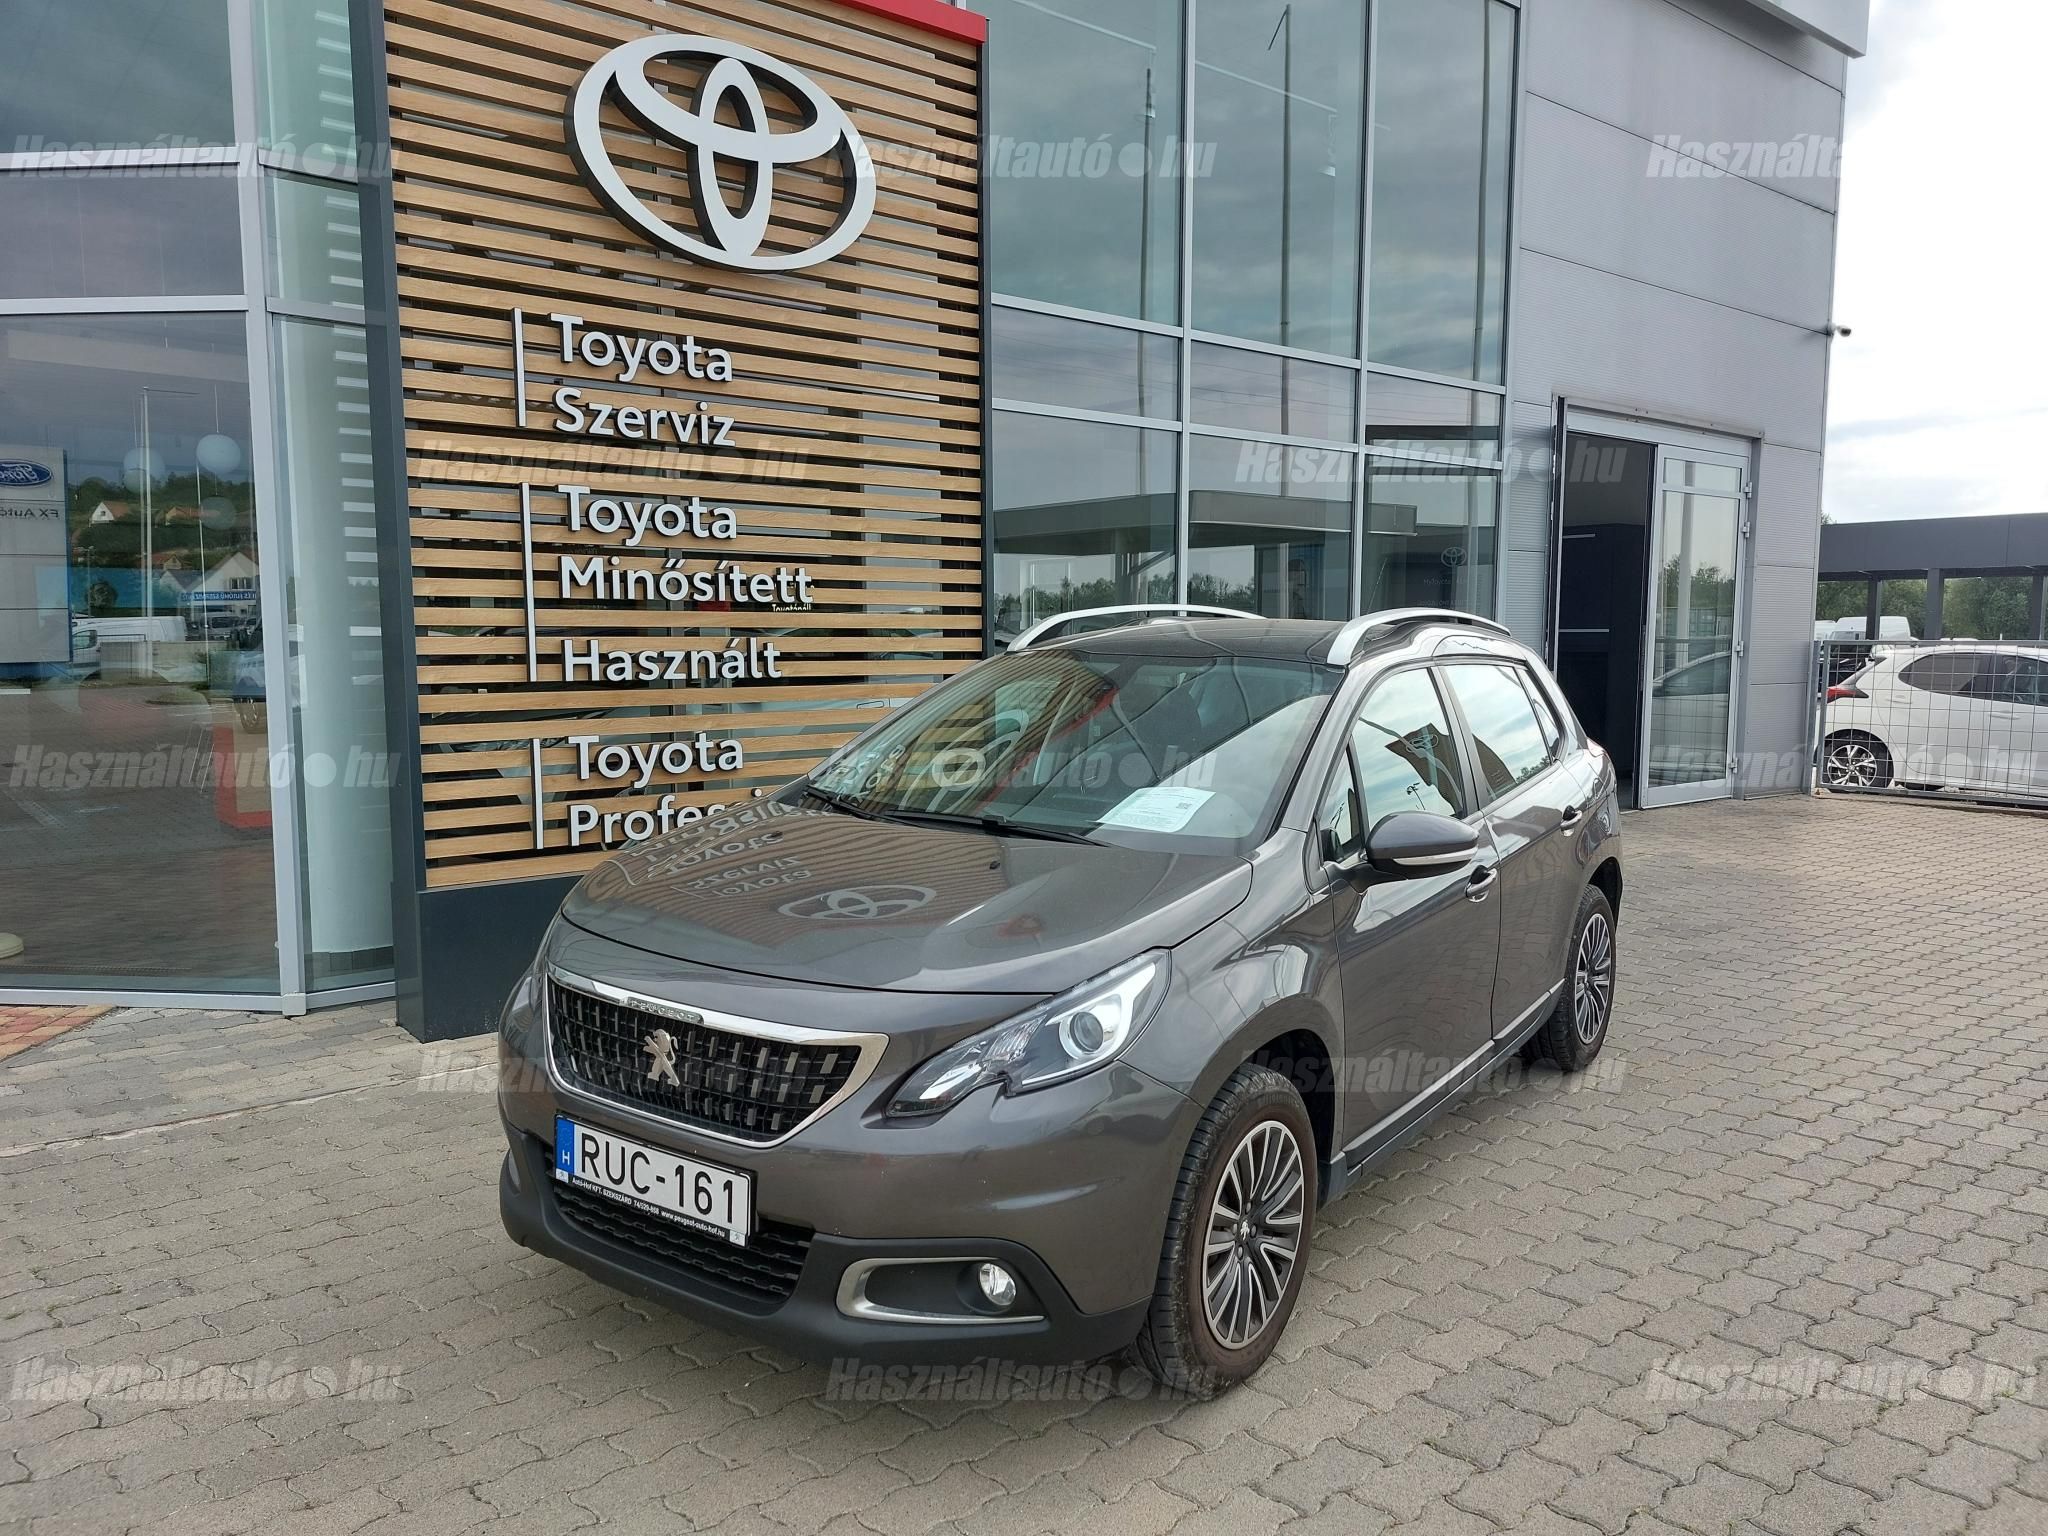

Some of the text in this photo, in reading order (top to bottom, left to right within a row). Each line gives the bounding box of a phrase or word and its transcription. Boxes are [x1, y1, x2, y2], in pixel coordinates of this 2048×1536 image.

[550, 312, 733, 382] Toyota
[553, 387, 736, 447] Szerviz
[556, 484, 738, 547] Toyota
[559, 555, 814, 603] Minősített
[562, 637, 782, 682] Használt
[566, 732, 744, 788] Toyota
[562, 1150, 570, 1166] H
[581, 1132, 733, 1224] RUC-161
